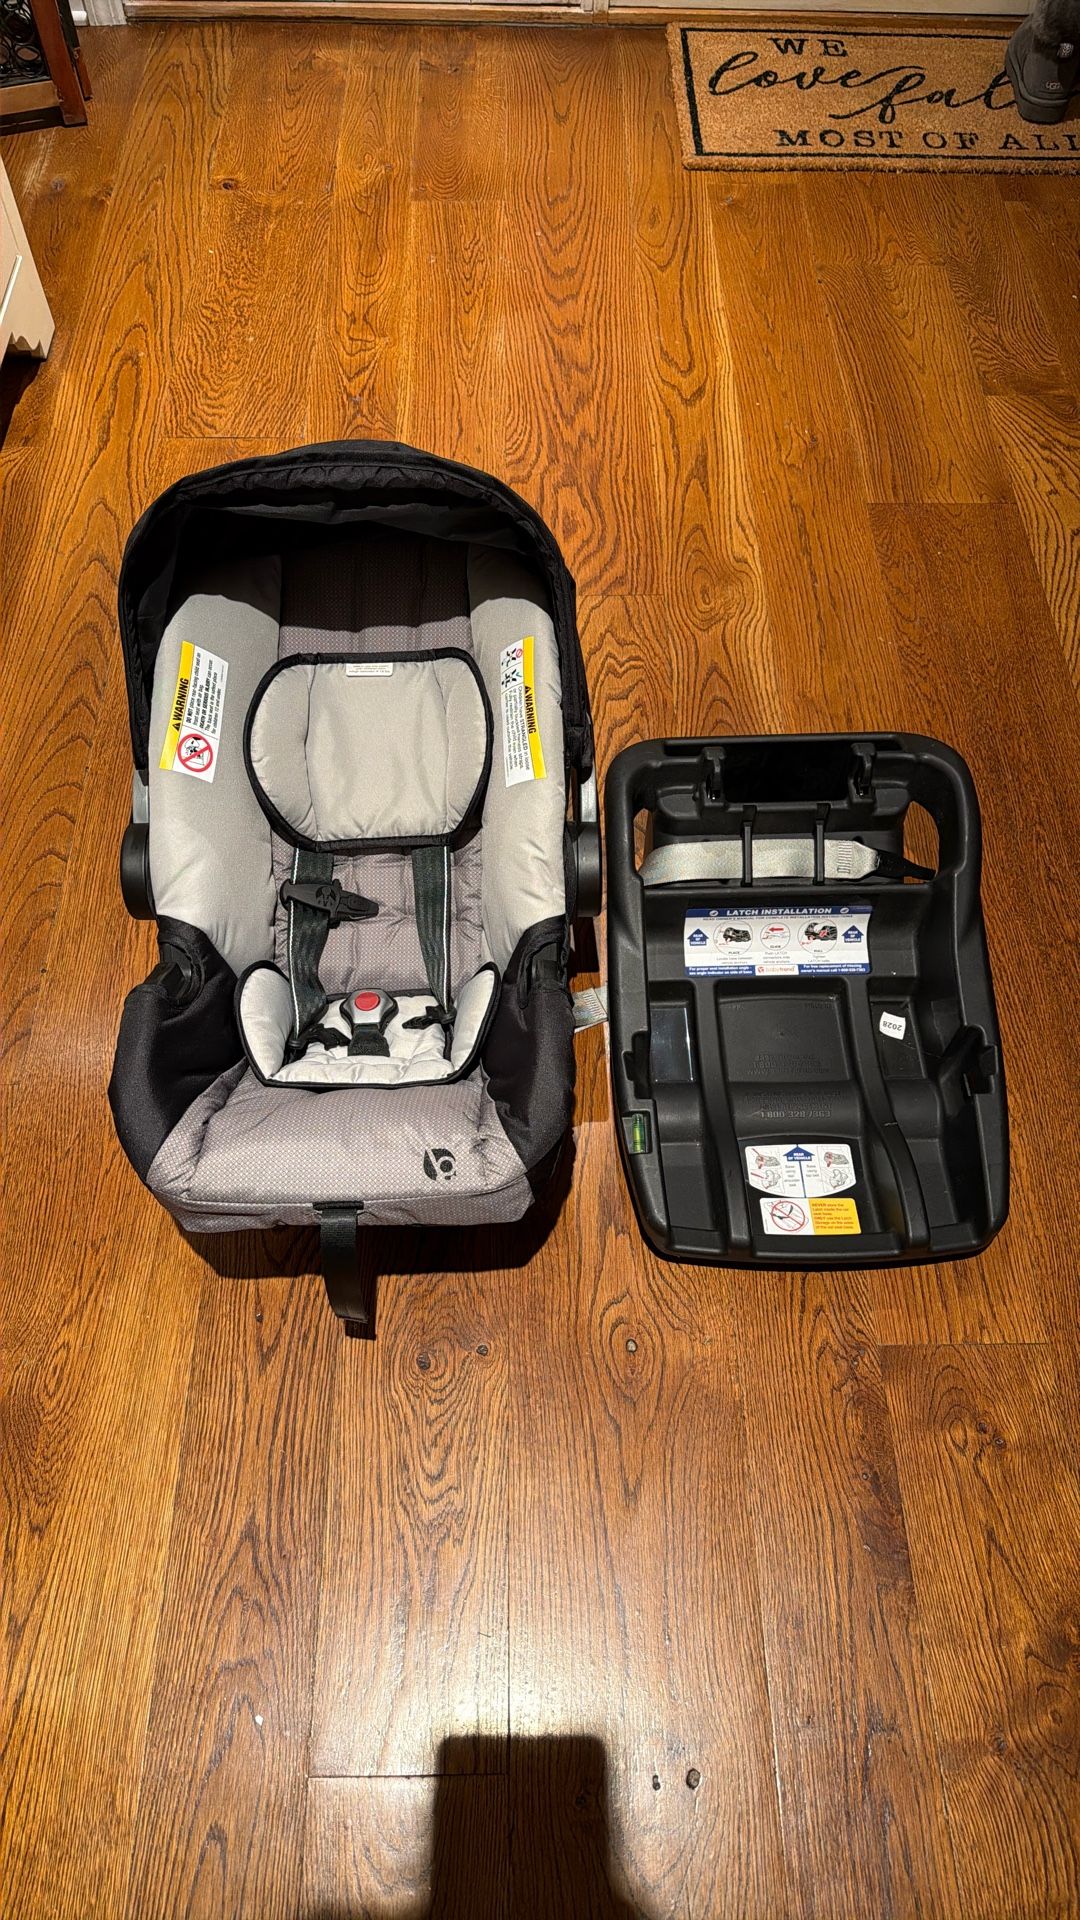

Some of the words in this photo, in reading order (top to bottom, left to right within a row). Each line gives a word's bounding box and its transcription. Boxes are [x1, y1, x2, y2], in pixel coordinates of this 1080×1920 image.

[767, 37, 849, 58] WE
[708, 51, 926, 97] love
[828, 72, 1017, 124] fal
[772, 129, 904, 149] MOST
[922, 131, 979, 150] OF
[173, 678, 189, 721] WARNING
[185, 716, 192, 724] DO
[525, 694, 536, 734] WARNING
[520, 719, 528, 751] STRANGLED
[761, 907, 832, 915] INSTALLATION
[882, 1020, 902, 1031] 2028
